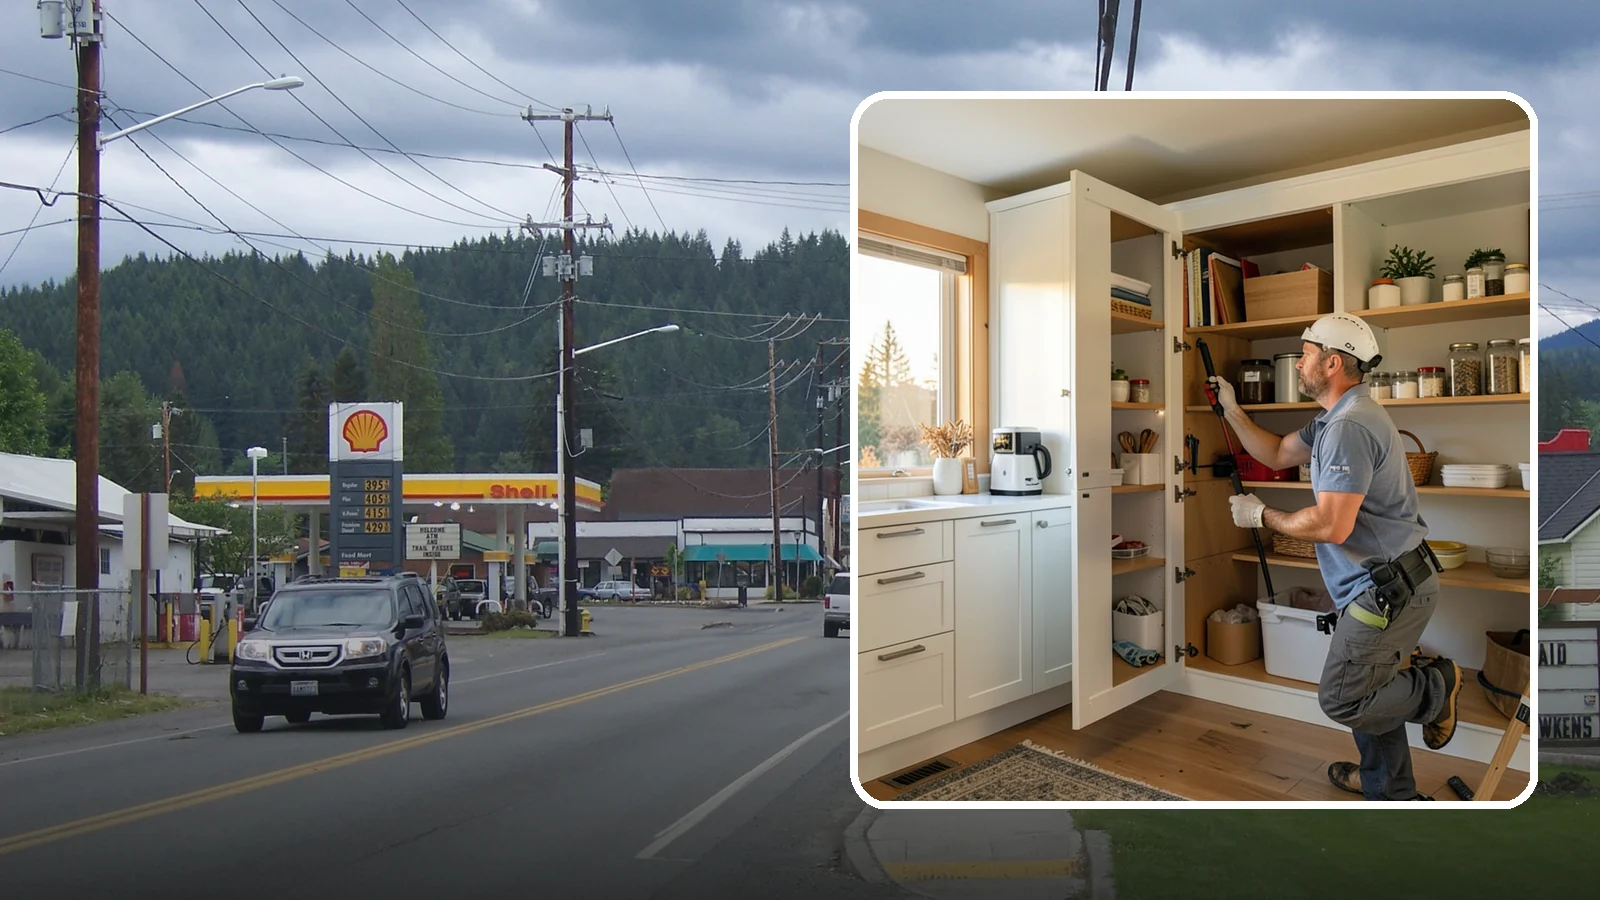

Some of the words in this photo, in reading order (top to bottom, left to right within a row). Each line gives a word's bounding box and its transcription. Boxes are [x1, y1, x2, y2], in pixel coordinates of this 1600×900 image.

[366, 480, 384, 490] 395
[490, 484, 547, 499] Shell
[366, 494, 384, 504] 405
[366, 508, 384, 518] 415
[366, 522, 384, 532] 429
[1538, 643, 1567, 666] AID
